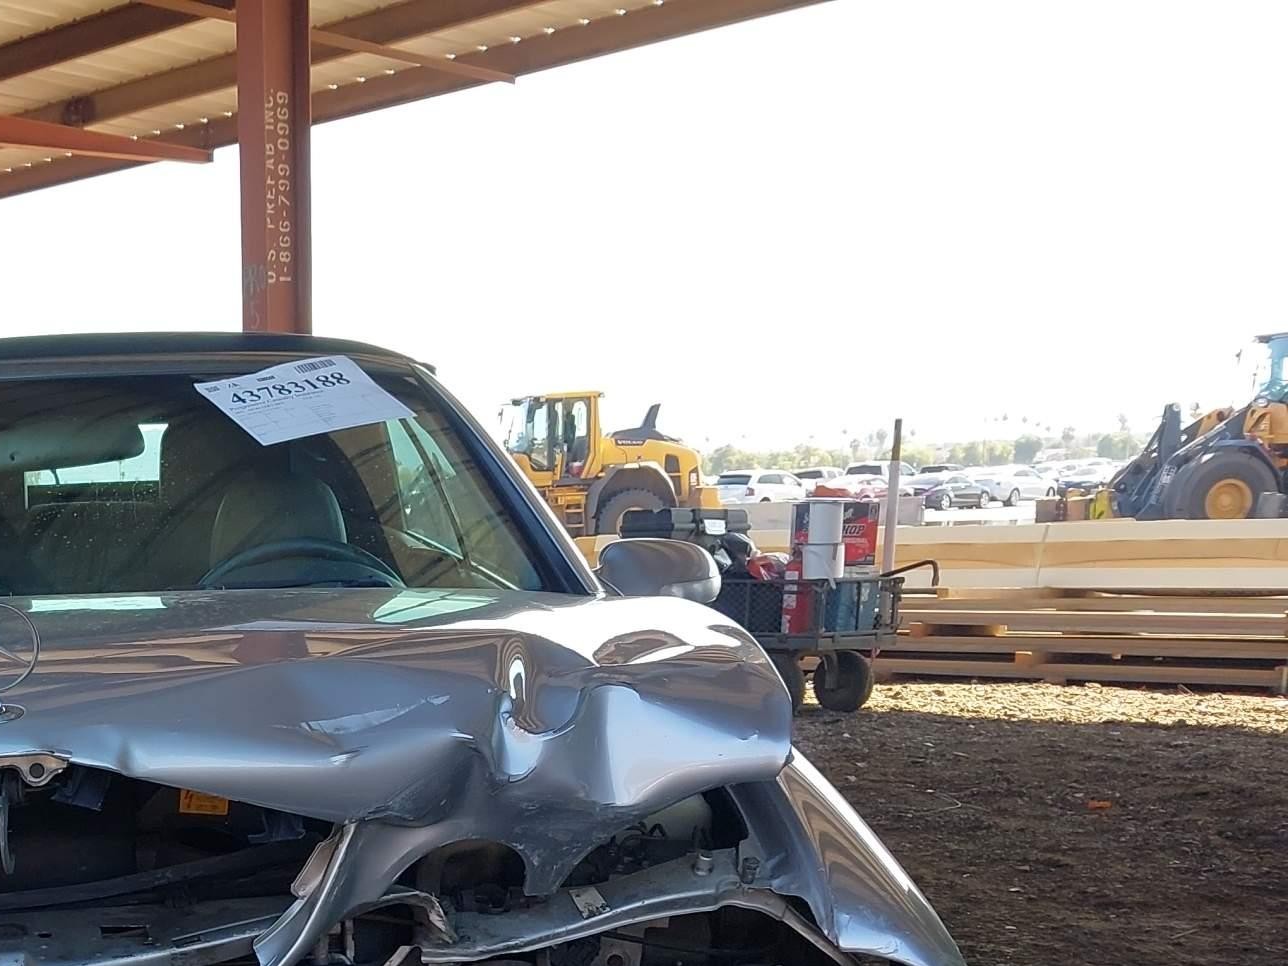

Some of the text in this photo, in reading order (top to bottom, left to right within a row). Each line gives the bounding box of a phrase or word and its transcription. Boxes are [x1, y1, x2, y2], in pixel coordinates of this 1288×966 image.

[265, 143, 275, 228] PREFAB
[276, 91, 292, 282] 1-866-799-0969
[230, 371, 351, 405] 43783188
[842, 525, 865, 536] HOP
